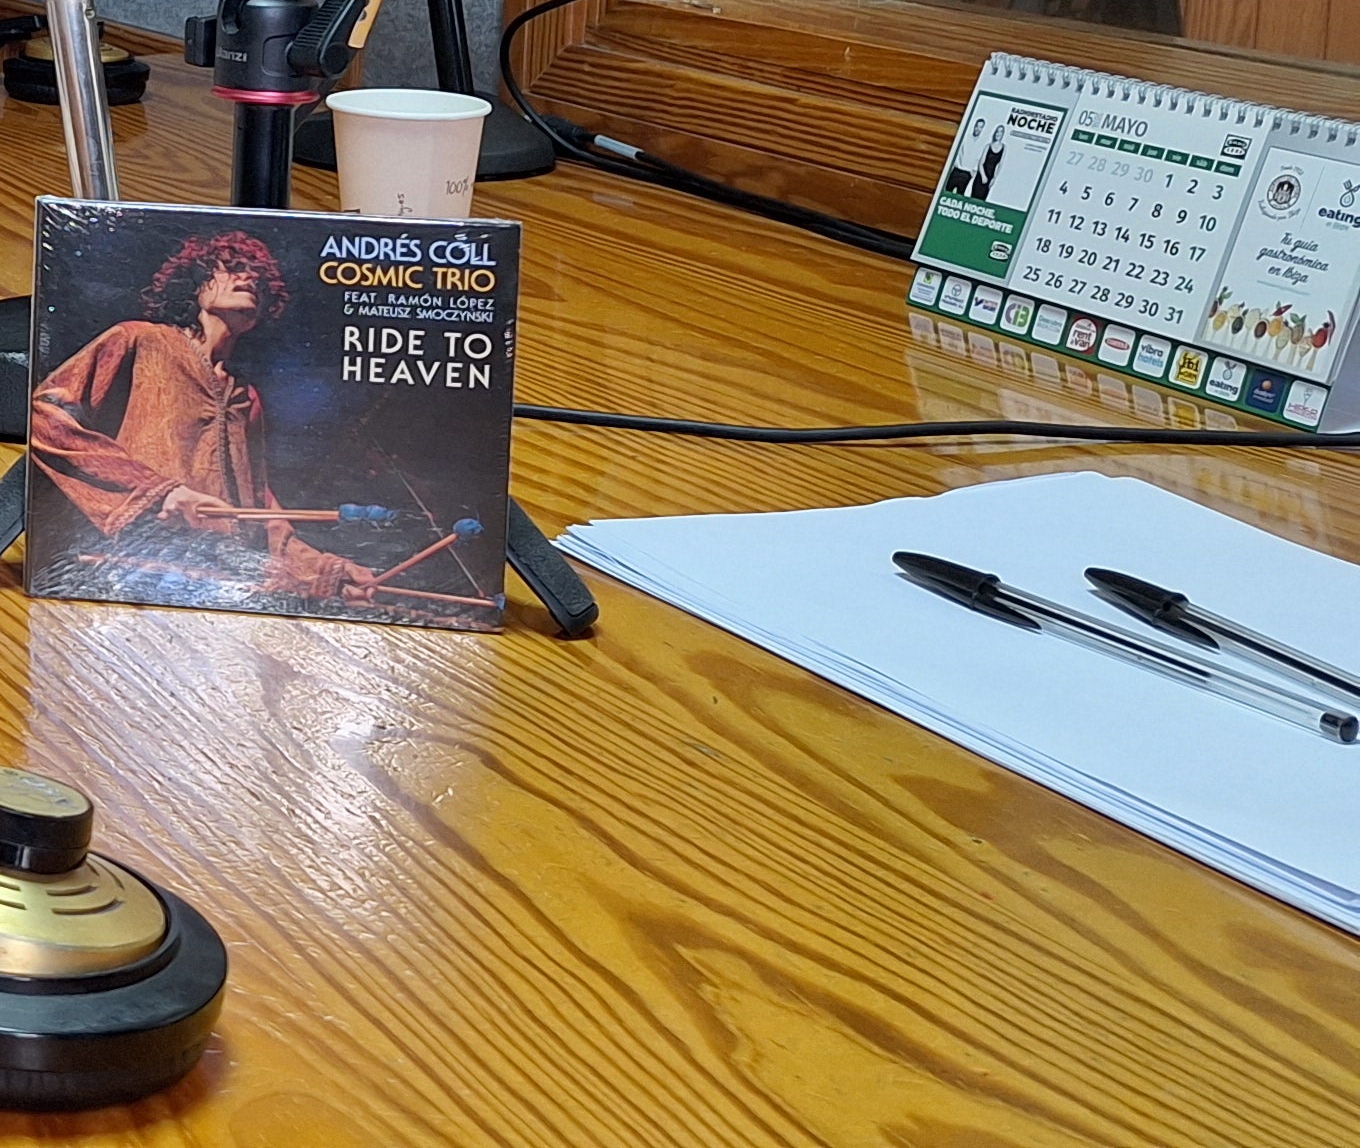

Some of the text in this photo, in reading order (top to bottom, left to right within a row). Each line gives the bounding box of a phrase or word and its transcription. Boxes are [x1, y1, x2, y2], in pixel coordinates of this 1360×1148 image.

[1006, 113, 1056, 135] NOCHE
[1079, 109, 1094, 127] 05
[1101, 113, 1149, 138] MAYO
[1067, 151, 1224, 200] 27 28 29 30 1 2 3
[939, 196, 963, 210] CADA
[1059, 180, 1217, 232] 4 5 6 7 8 9 10
[937, 205, 1014, 234] TODO EL DEPORTE
[320, 233, 423, 263] ANDRÉS
[1047, 209, 1206, 262] 11 12 13 14 15 16 17
[1281, 232, 1319, 252] Tu guía
[1036, 238, 1194, 294] 18 19 20 21 22 23 24
[1256, 246, 1330, 272] gastronómica
[319, 261, 496, 293] COSMIC TRIO
[1268, 265, 1309, 286] en Ibiza
[344, 291, 495, 310] FEAT RAMÓN LÓPEZ
[1023, 266, 1183, 324] 25 26 27 28 29 30 31
[343, 303, 354, 316] &
[358, 305, 412, 319] MATEUSZ
[343, 325, 493, 360] RIDE TO
[342, 355, 492, 390] HEAVEN
[1209, 378, 1239, 396] eating
